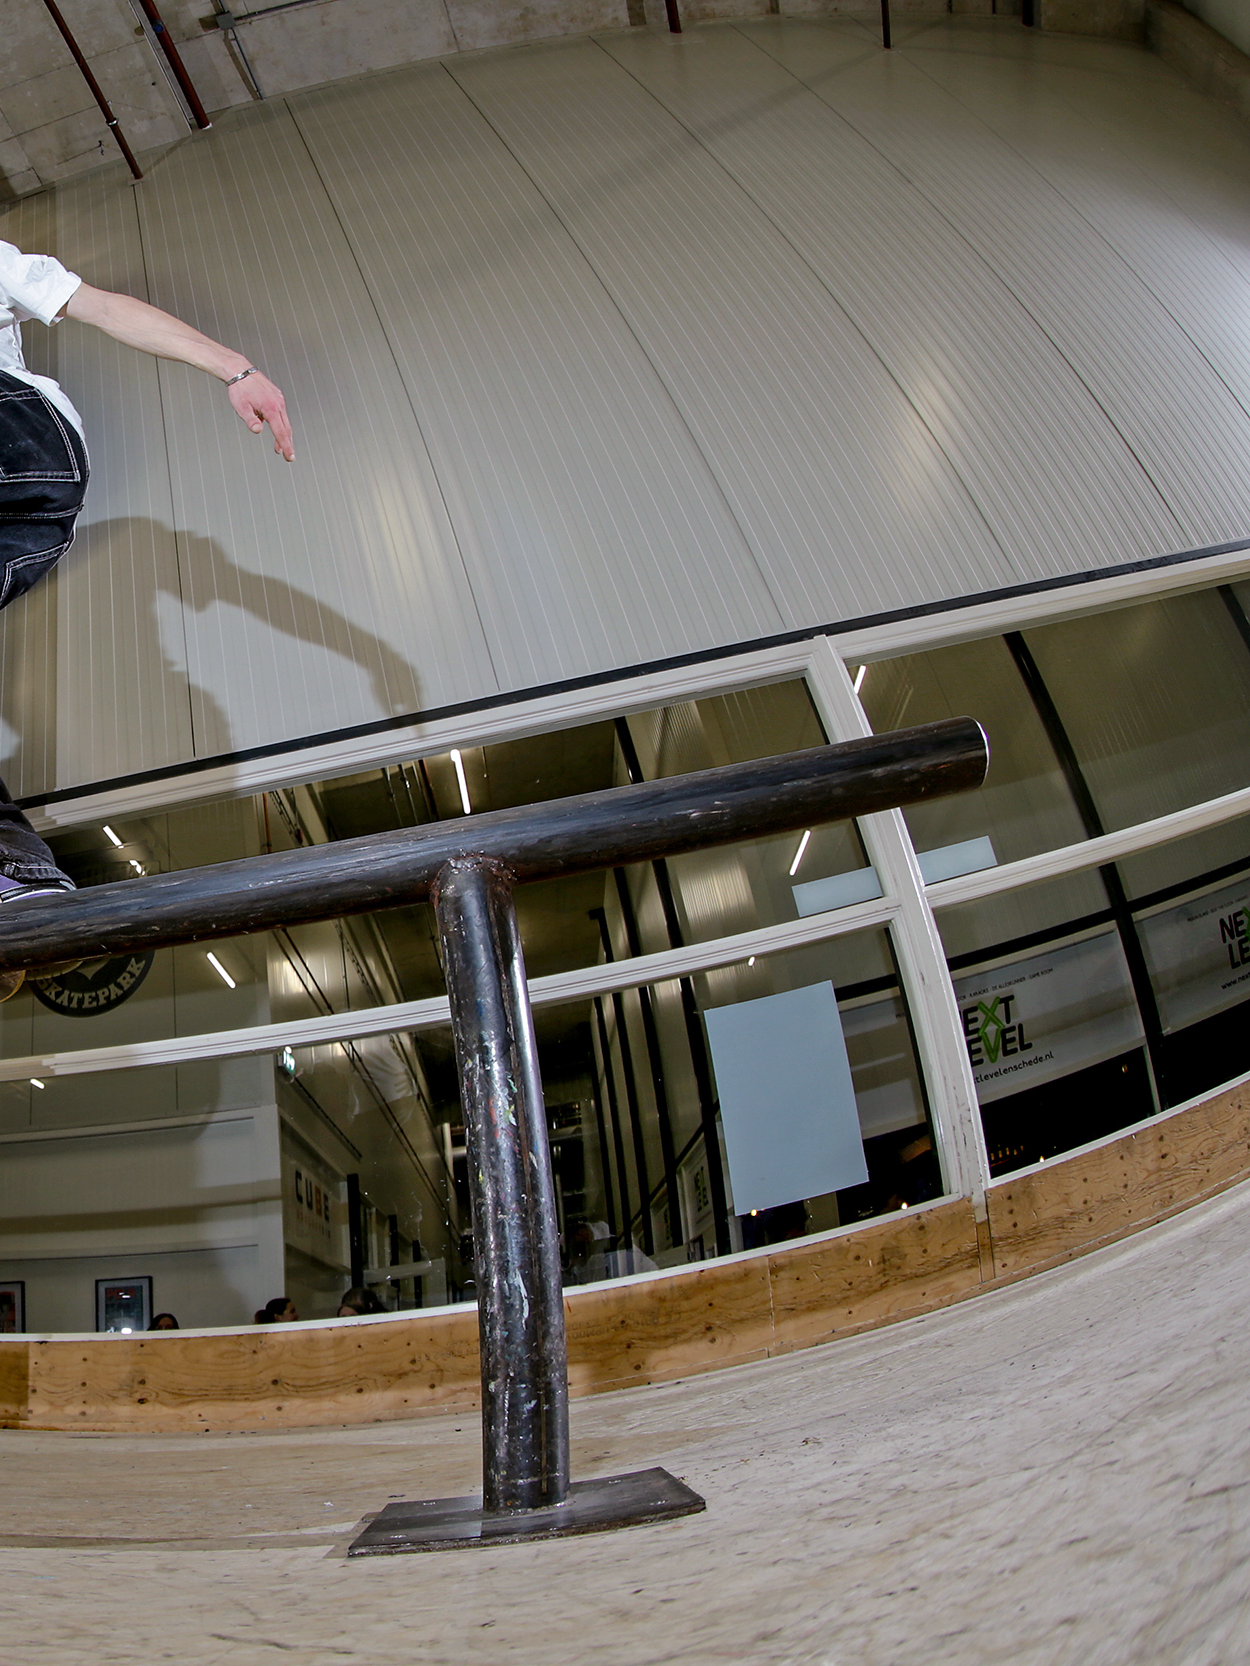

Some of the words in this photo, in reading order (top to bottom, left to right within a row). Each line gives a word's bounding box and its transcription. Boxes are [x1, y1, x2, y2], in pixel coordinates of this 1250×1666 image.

[961, 996, 1015, 1038] EXT
[966, 1023, 1033, 1067] EVEL
[974, 1050, 1055, 1084] tlevelenschede.nl
